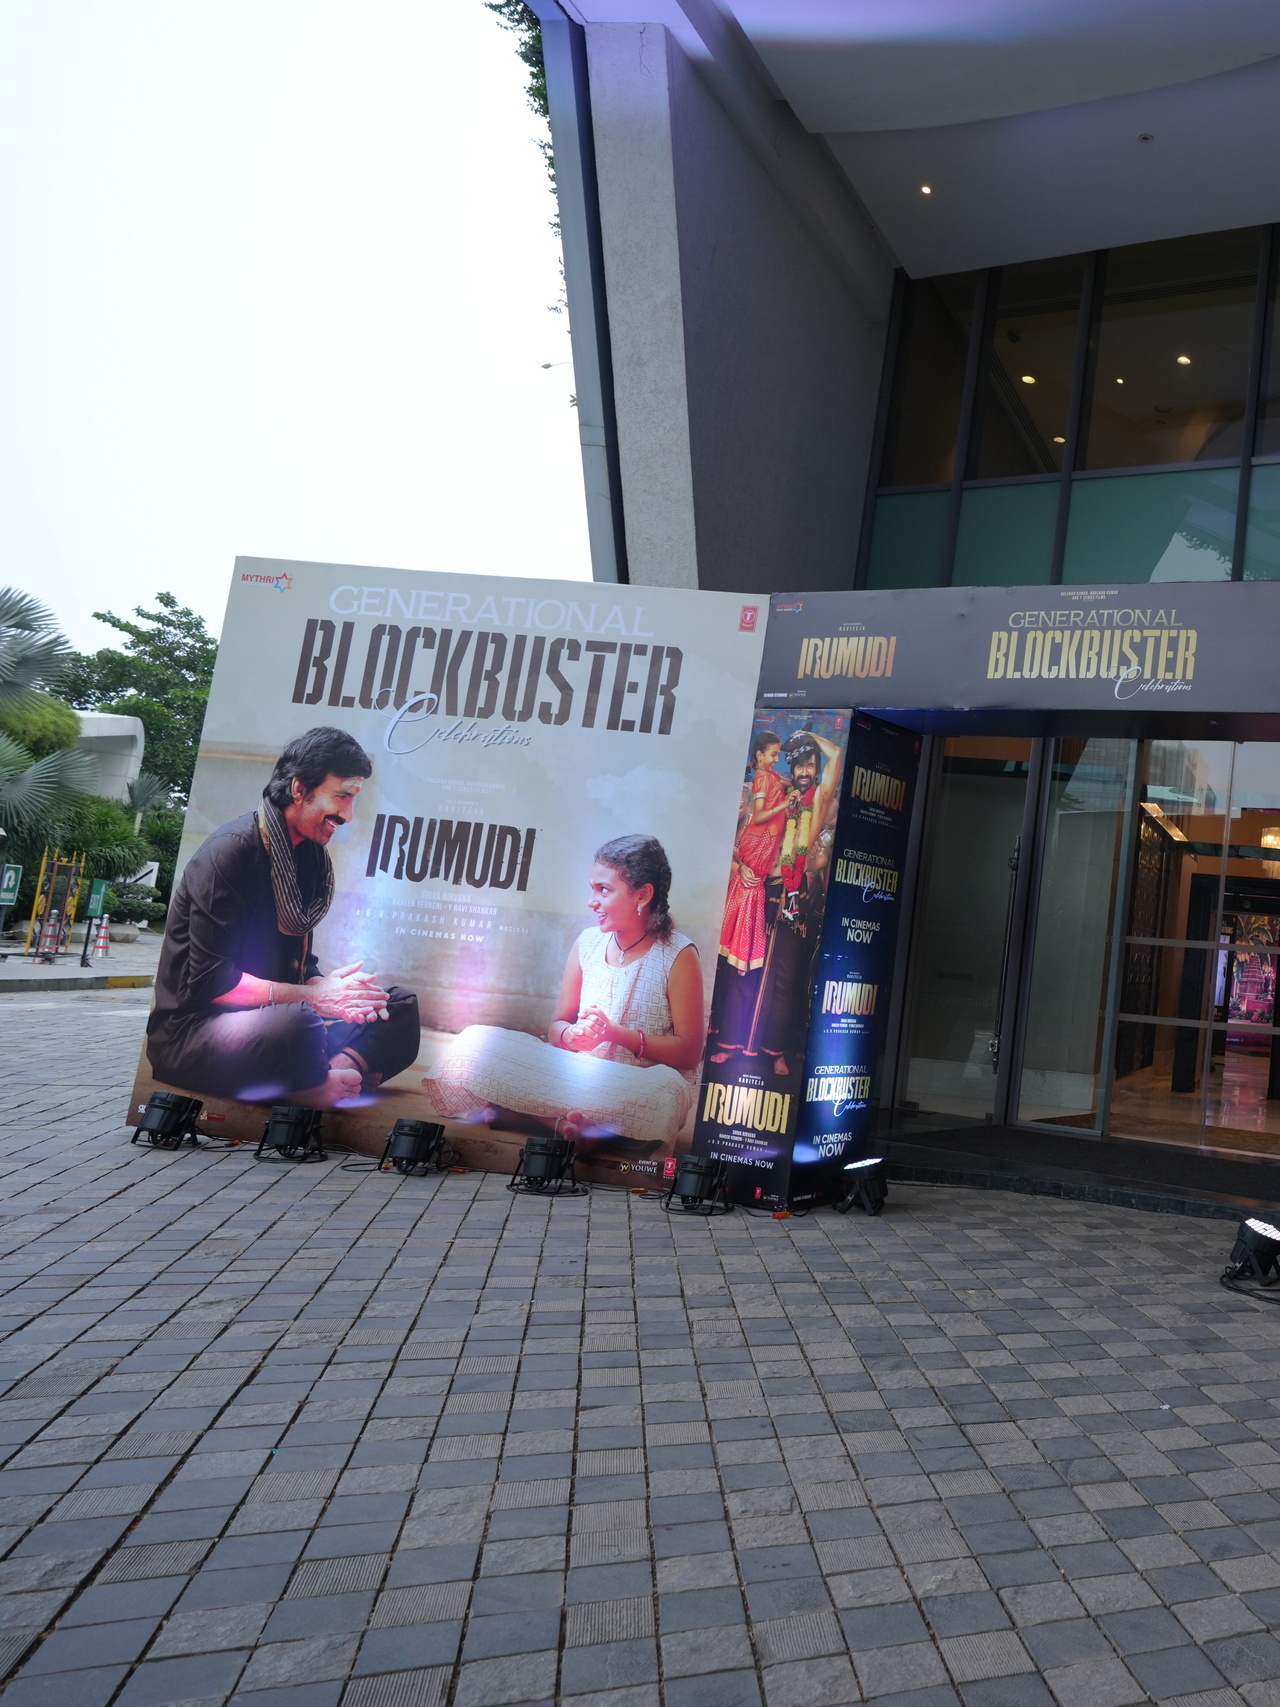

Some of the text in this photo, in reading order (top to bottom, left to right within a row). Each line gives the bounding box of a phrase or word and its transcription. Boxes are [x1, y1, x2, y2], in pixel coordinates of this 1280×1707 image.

[241, 573, 275, 584] MYTHRI
[328, 585, 655, 638] GENERATIONAL
[1008, 608, 1183, 628] GENERATIONAL
[796, 635, 897, 679] IRUMUDI
[986, 629, 1198, 680] BLOCKBUSTER
[292, 618, 684, 735] BLOCKBUSTER
[1108, 665, 1192, 700] Celebrations
[374, 688, 534, 755] Celebrations
[850, 765, 906, 812] IRUMUDI
[438, 804, 484, 816] RAVITEJA
[365, 813, 537, 892] IRUMUDI
[843, 848, 895, 867] GENERATIONAL
[835, 858, 899, 893] BLOCKBUSTER
[421, 890, 471, 903] SHIVA NIRVANA
[391, 899, 416, 908] NAVEEN
[416, 900, 443, 911] YERNENI
[453, 903, 468, 914] RAVI
[468, 905, 498, 916] SHANKAR
[453, 917, 492, 929] KUMAR
[499, 926, 529, 934] MUSICAL
[841, 917, 880, 932] IN CINEMAS
[395, 927, 484, 943] IN CINEMAS NOW
[846, 928, 873, 944] NOW
[821, 980, 878, 1016] IRUMUDI
[814, 1065, 868, 1075] GENERATIONAL
[738, 1077, 764, 1086] RAVITEJA
[806, 1076, 871, 1103] BLOCKBUSTER
[702, 1082, 791, 1134] IRUMUDI
[812, 1132, 853, 1145] IN CINEMAS
[818, 1142, 845, 1158] NOW
[631, 1164, 657, 1174] YOUWE
[710, 1151, 774, 1170] IN CINEMAS NOW
